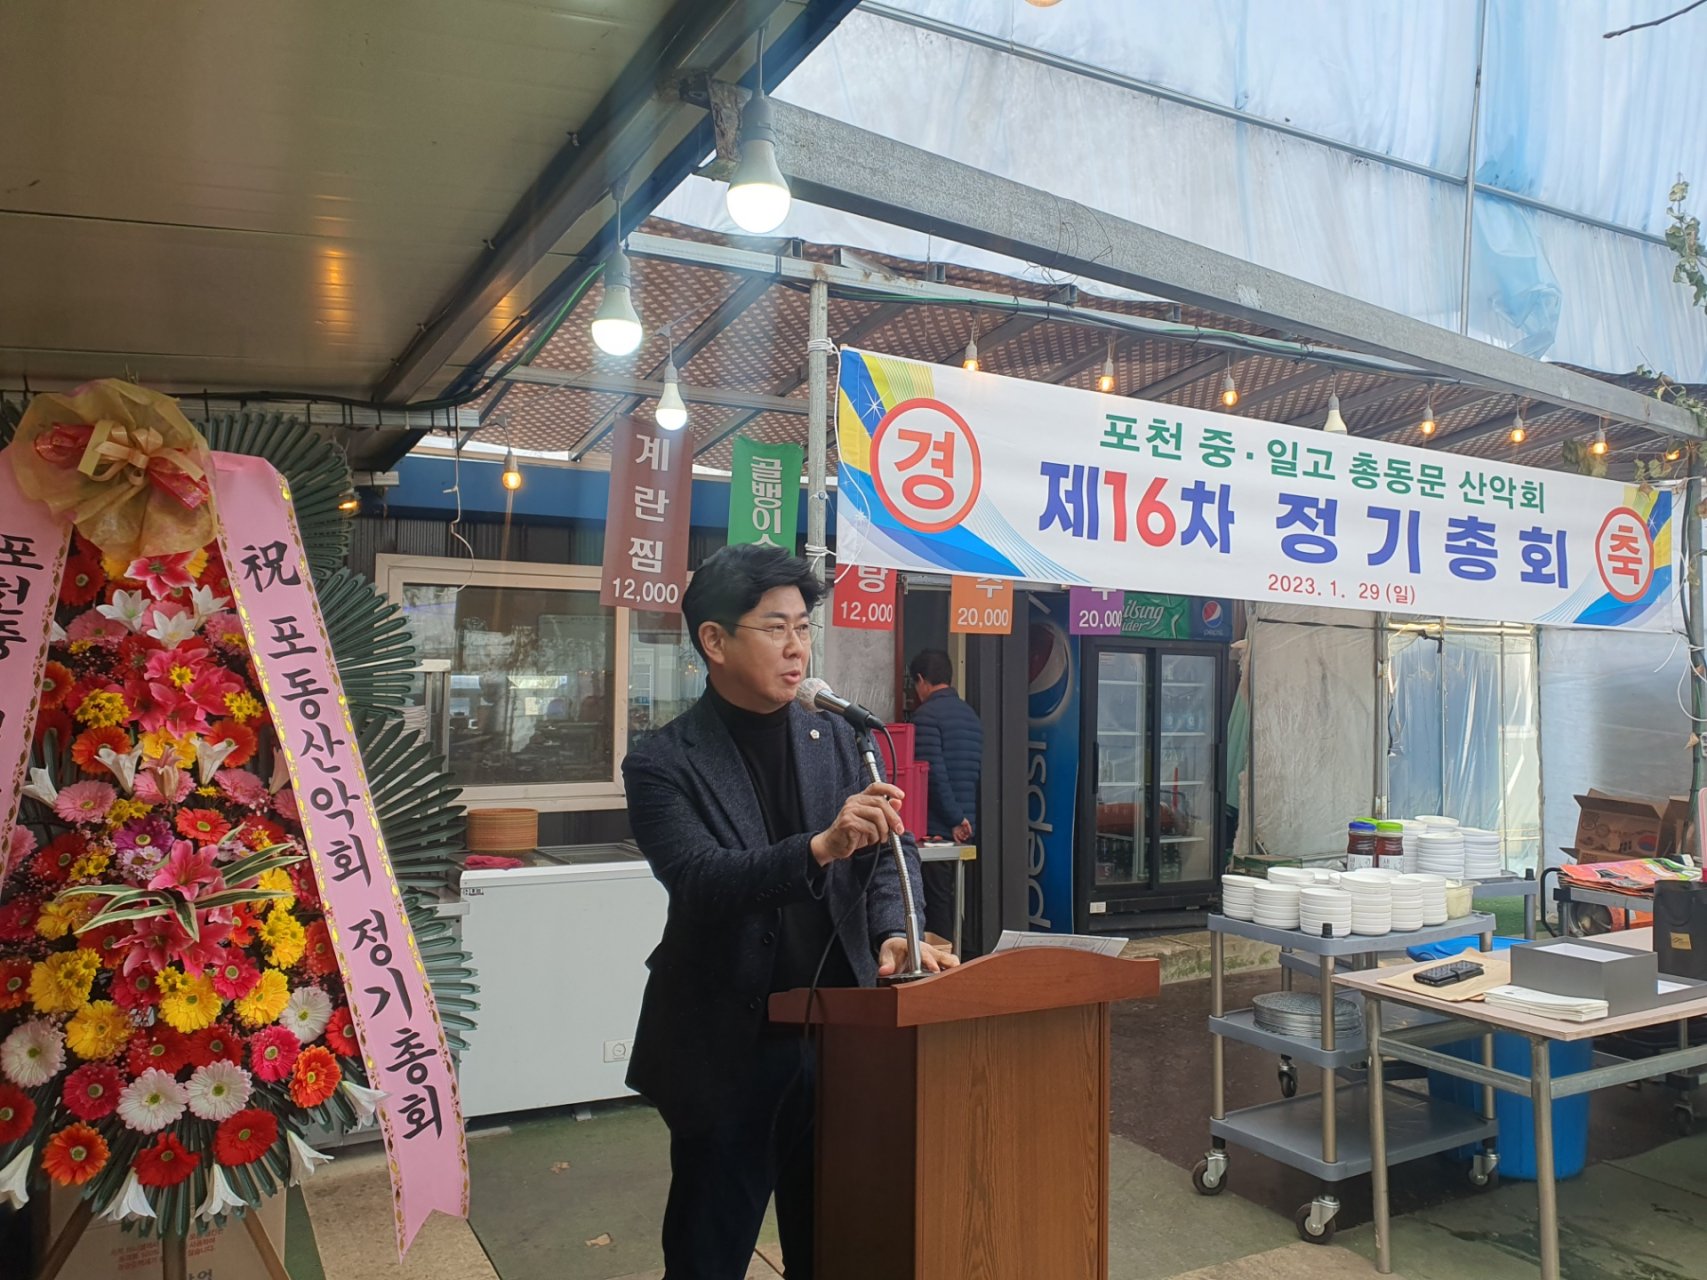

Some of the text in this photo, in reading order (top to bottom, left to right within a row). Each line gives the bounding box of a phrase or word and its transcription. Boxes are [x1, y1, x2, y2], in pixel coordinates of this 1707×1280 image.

[893, 427, 956, 511] 경
[1099, 413, 1183, 461] 포천
[1348, 451, 1447, 499] 총동문
[1457, 469, 1546, 514] 산악회
[627, 433, 672, 574] 계란찜
[1040, 462, 1235, 553] 제16차
[241, 540, 302, 593] 祝
[1606, 523, 1645, 586] 축
[612, 577, 680, 604] 12,000
[1267, 573, 1322, 597] 2023.
[840, 601, 894, 623] 12,000
[956, 607, 1010, 628] 20,000
[1079, 610, 1122, 629] 20,000
[1122, 621, 1150, 632] ider
[1123, 599, 1165, 631] ilsung
[267, 614, 371, 887] 포동산악회
[347, 909, 444, 1142] 정기총회
